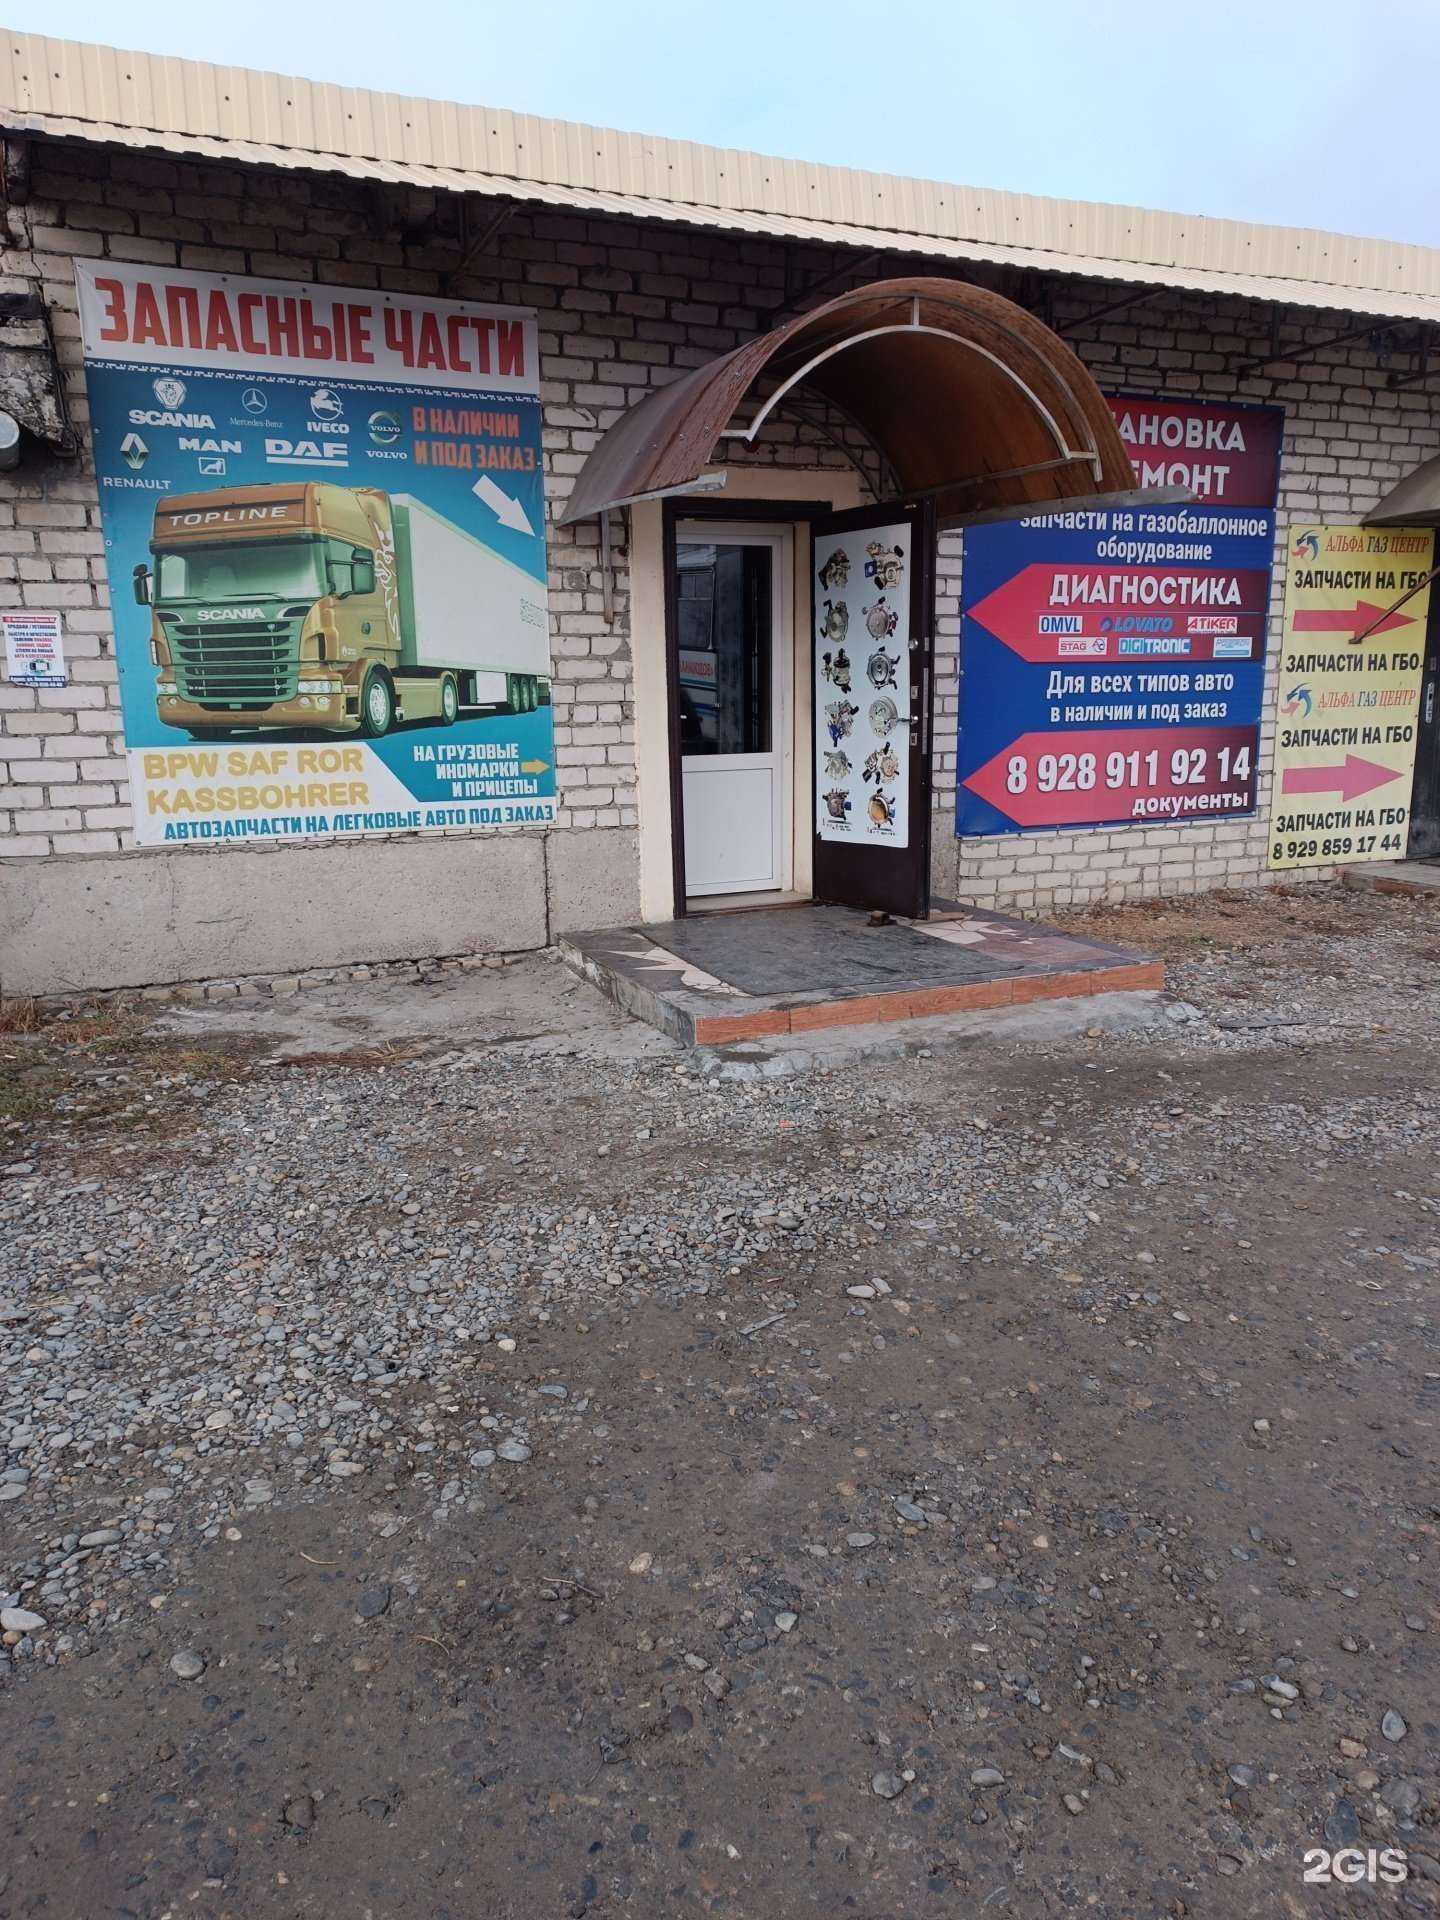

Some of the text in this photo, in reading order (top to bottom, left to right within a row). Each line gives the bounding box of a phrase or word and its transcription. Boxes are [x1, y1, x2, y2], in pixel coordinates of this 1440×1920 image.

[95, 277, 525, 378] ЗАПАСНЫЕ ЧАСТИ
[129, 410, 216, 429] SCANIA
[307, 421, 349, 434] IVECO
[370, 425, 400, 433] VOLVO
[413, 407, 519, 438] В НАЛИЧИИ
[1112, 411, 1246, 452] АНОВКА
[178, 437, 242, 453] MAN
[265, 438, 349, 458] DAF
[366, 450, 408, 460] VOLVO
[415, 440, 536, 471] И ПОД ЗАКАЗ
[103, 477, 171, 490] RENAULT
[169, 506, 288, 527] TOPLINE
[1112, 513, 1133, 531] на
[1139, 509, 1268, 537] газобаллонное
[1097, 535, 1212, 563] оборудование
[1325, 535, 1430, 556] АЛЬФА ГАЗ ЦЕНТР
[1050, 574, 1241, 606] ДИАГНОСТИКА
[1295, 570, 1371, 589] ЗАПЧАСТИ
[1376, 571, 1395, 588] НА
[197, 607, 265, 621] SCANIA
[1041, 616, 1080, 632] OMVL
[1113, 616, 1173, 633] LOVATO
[1060, 642, 1087, 651] STAG
[1119, 638, 1191, 654] DIGITRONIC
[1286, 652, 1419, 673] ЗАПЧАСТИ НА ГБО
[1047, 671, 1234, 698] Для всех типов авто
[1318, 690, 1416, 708] АЛЬФА ГАЗ ЦЕНТР
[1050, 702, 1227, 722] в наличии и под заказ
[1281, 725, 1413, 748] ЗАПЧАСТИ НА ГБО
[413, 743, 519, 761] НА ГРУЗОВЫЕ
[144, 748, 364, 779] BPW SAF ROR
[436, 761, 519, 779] ИНОМАРКИ
[1007, 746, 1250, 794] 8 928 911 92 14
[147, 782, 370, 815] KASSBOHRER
[452, 779, 538, 797] И ПРИЦЕПЫ
[1132, 792, 1248, 818] документы
[164, 804, 554, 840] АВТОЗАПЧАСТИ НА ЛЕГКОВЫЕ АВТО ПОД ЗАКАЗ
[1276, 808, 1406, 833] ЗАПЧАСТИ НА ГБО
[1272, 834, 1402, 860] 8 929 859 17 44
